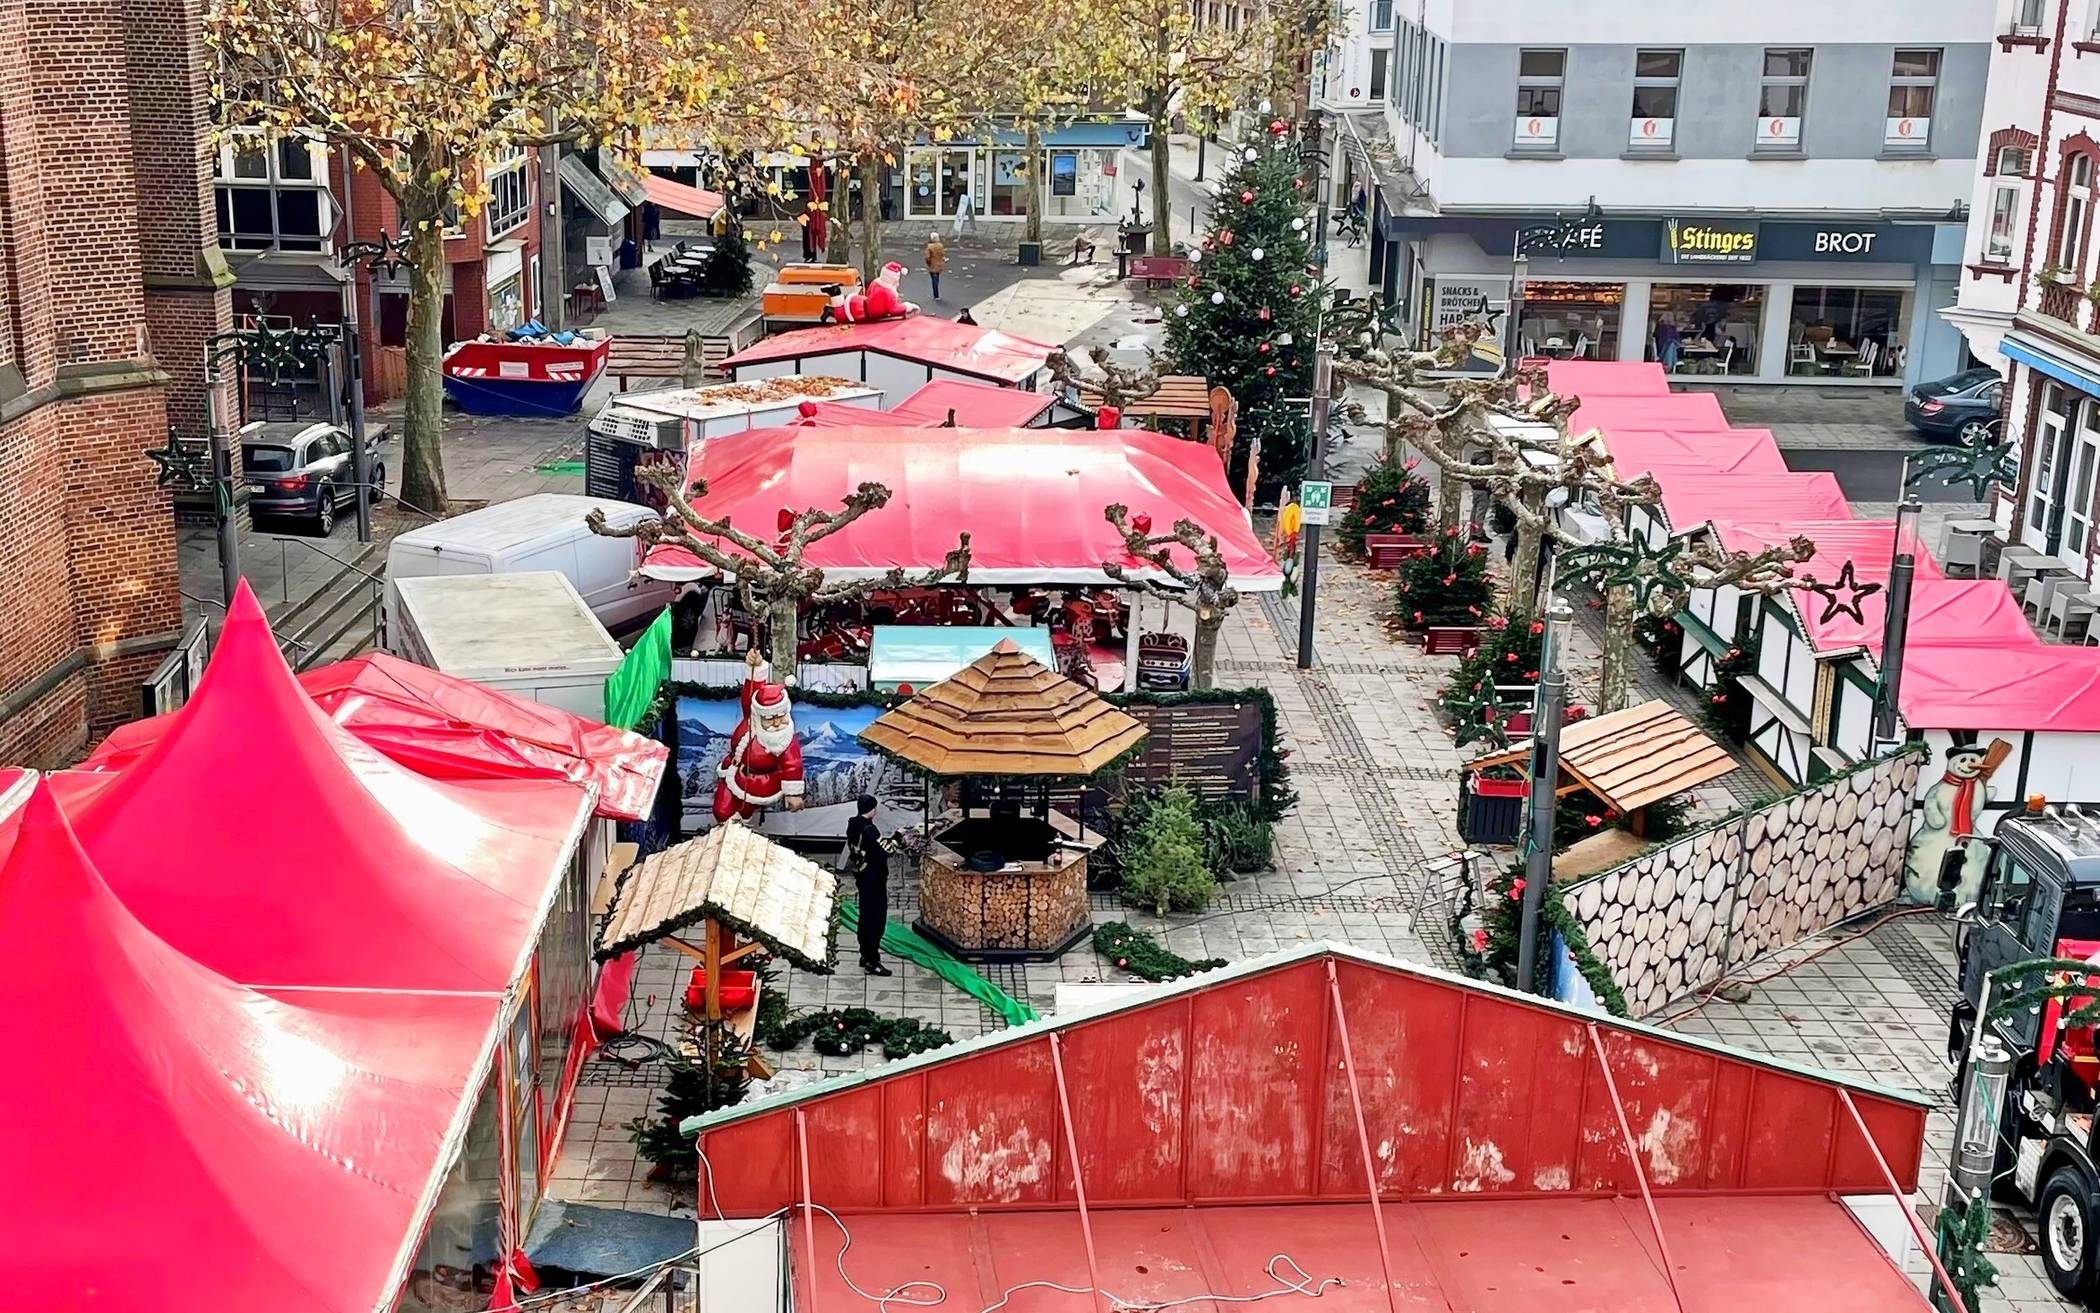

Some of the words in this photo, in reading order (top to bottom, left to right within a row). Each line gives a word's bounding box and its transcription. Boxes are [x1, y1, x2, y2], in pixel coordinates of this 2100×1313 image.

[1680, 227, 1754, 253] Stinges
[1815, 232, 1877, 253] BROT
[1441, 286, 1472, 296] SNACKS
